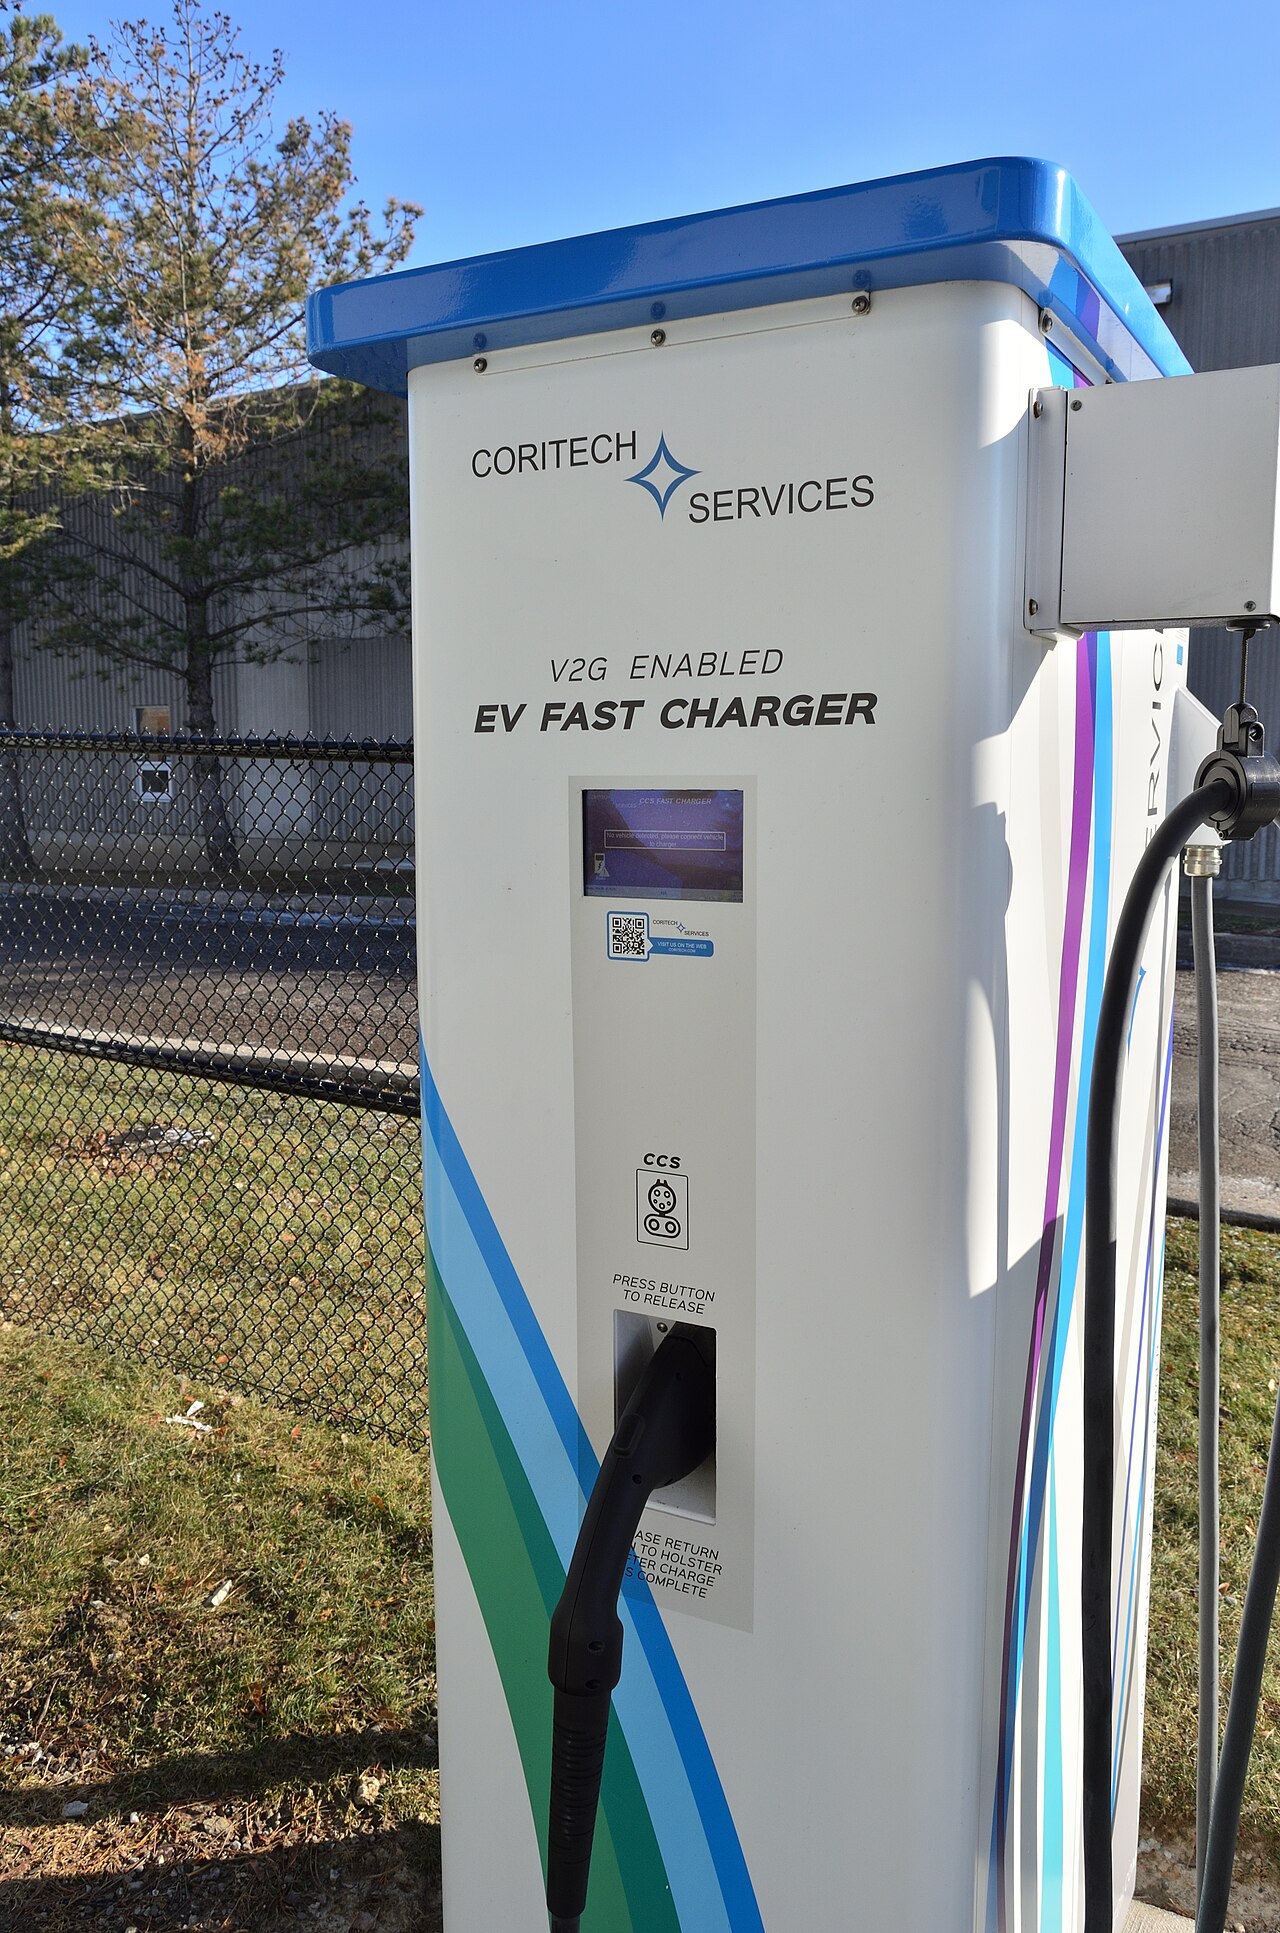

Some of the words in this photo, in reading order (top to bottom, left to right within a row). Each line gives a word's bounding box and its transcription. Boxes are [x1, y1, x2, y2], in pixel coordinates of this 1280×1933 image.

[471, 430, 637, 478] CORITECH
[688, 474, 875, 524] SERVICES
[549, 657, 608, 682] V2G
[629, 648, 784, 680] ENABLED
[473, 703, 527, 733] EV
[539, 700, 646, 732] FAST
[659, 692, 878, 729] CHARGER
[639, 797, 655, 805] CCS
[656, 797, 674, 805] FAST
[675, 797, 712, 806] CHARGER
[703, 833, 724, 842] vehicle
[643, 1152, 681, 1169] CCS
[612, 1273, 656, 1291] PRESS
[659, 1282, 716, 1302] BUTTON
[623, 1289, 640, 1302] TO
[644, 1293, 706, 1315] RELEASE
[634, 1529, 662, 1546] ASE
[664, 1537, 720, 1561] RETURN
[640, 1543, 657, 1557] TO
[660, 1551, 723, 1576] HOLSTER
[624, 1566, 634, 1578] S
[637, 1570, 708, 1599] COMPLETE
[659, 1563, 716, 1587] CHARGE
